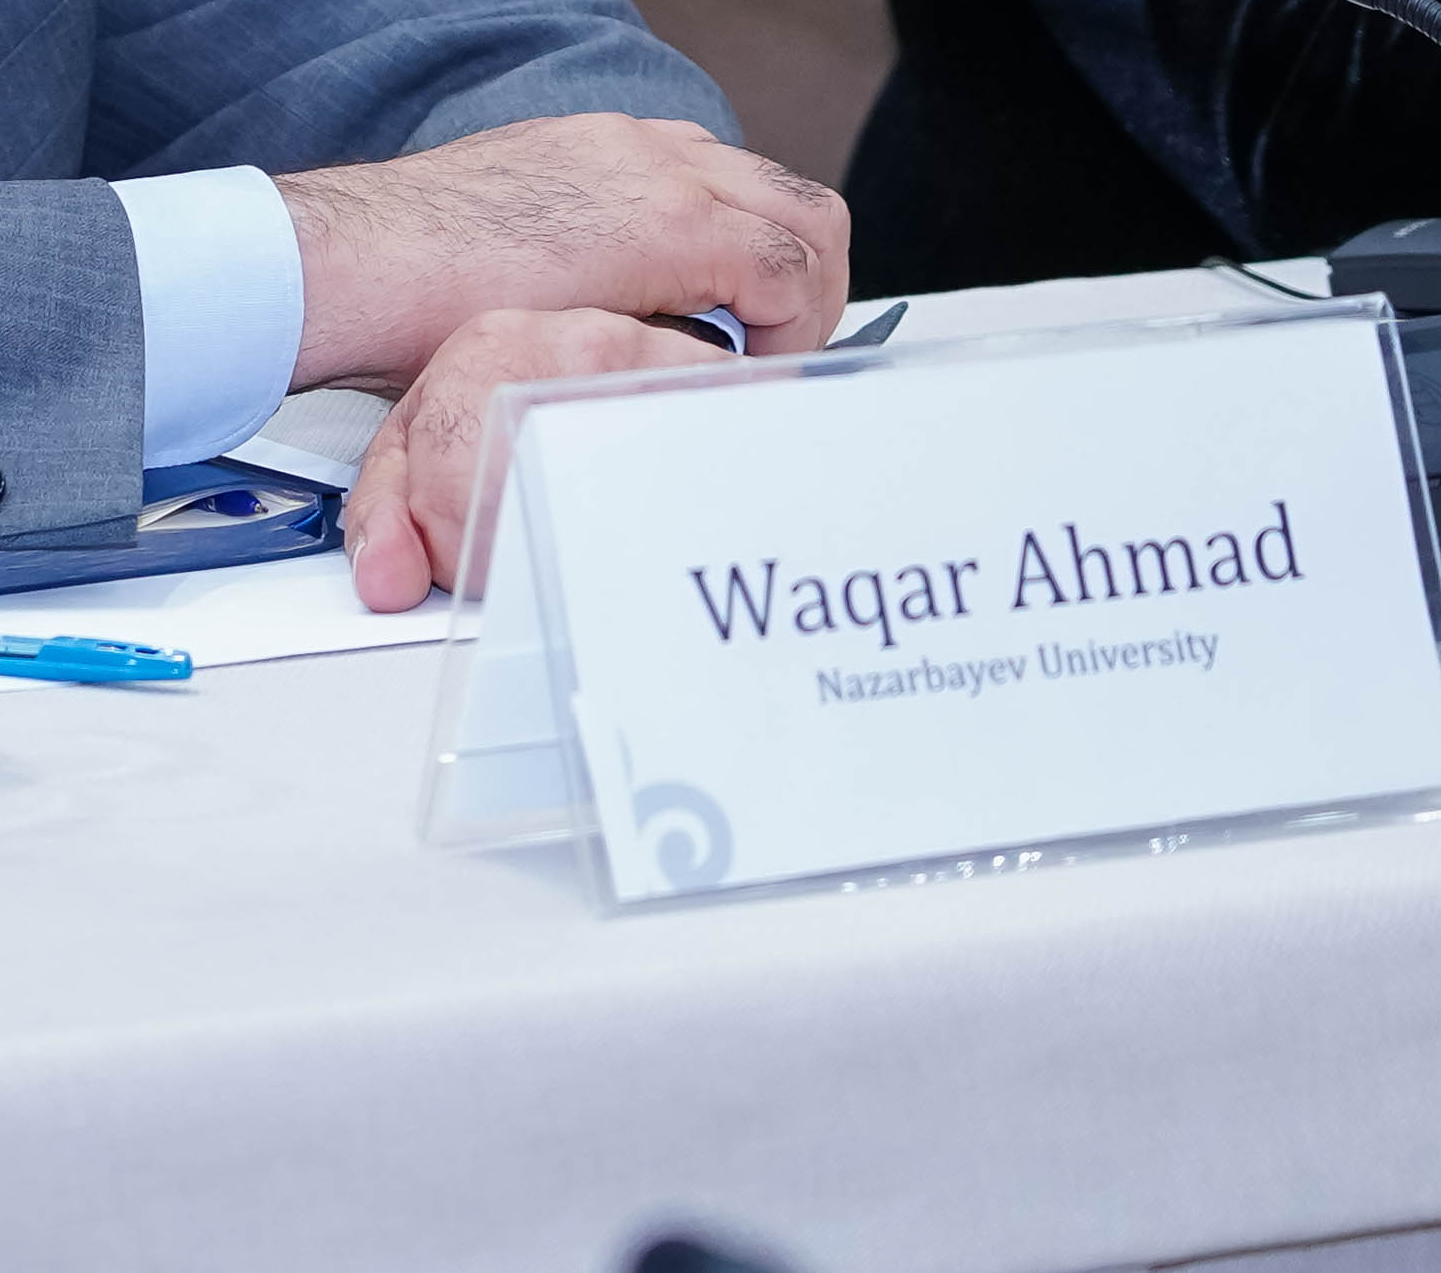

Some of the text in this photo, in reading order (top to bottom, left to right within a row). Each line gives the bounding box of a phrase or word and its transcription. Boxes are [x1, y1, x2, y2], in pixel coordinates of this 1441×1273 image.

[687, 500, 1305, 651] Waqar Ahmad
[815, 630, 1220, 705] Nazarbayev University
